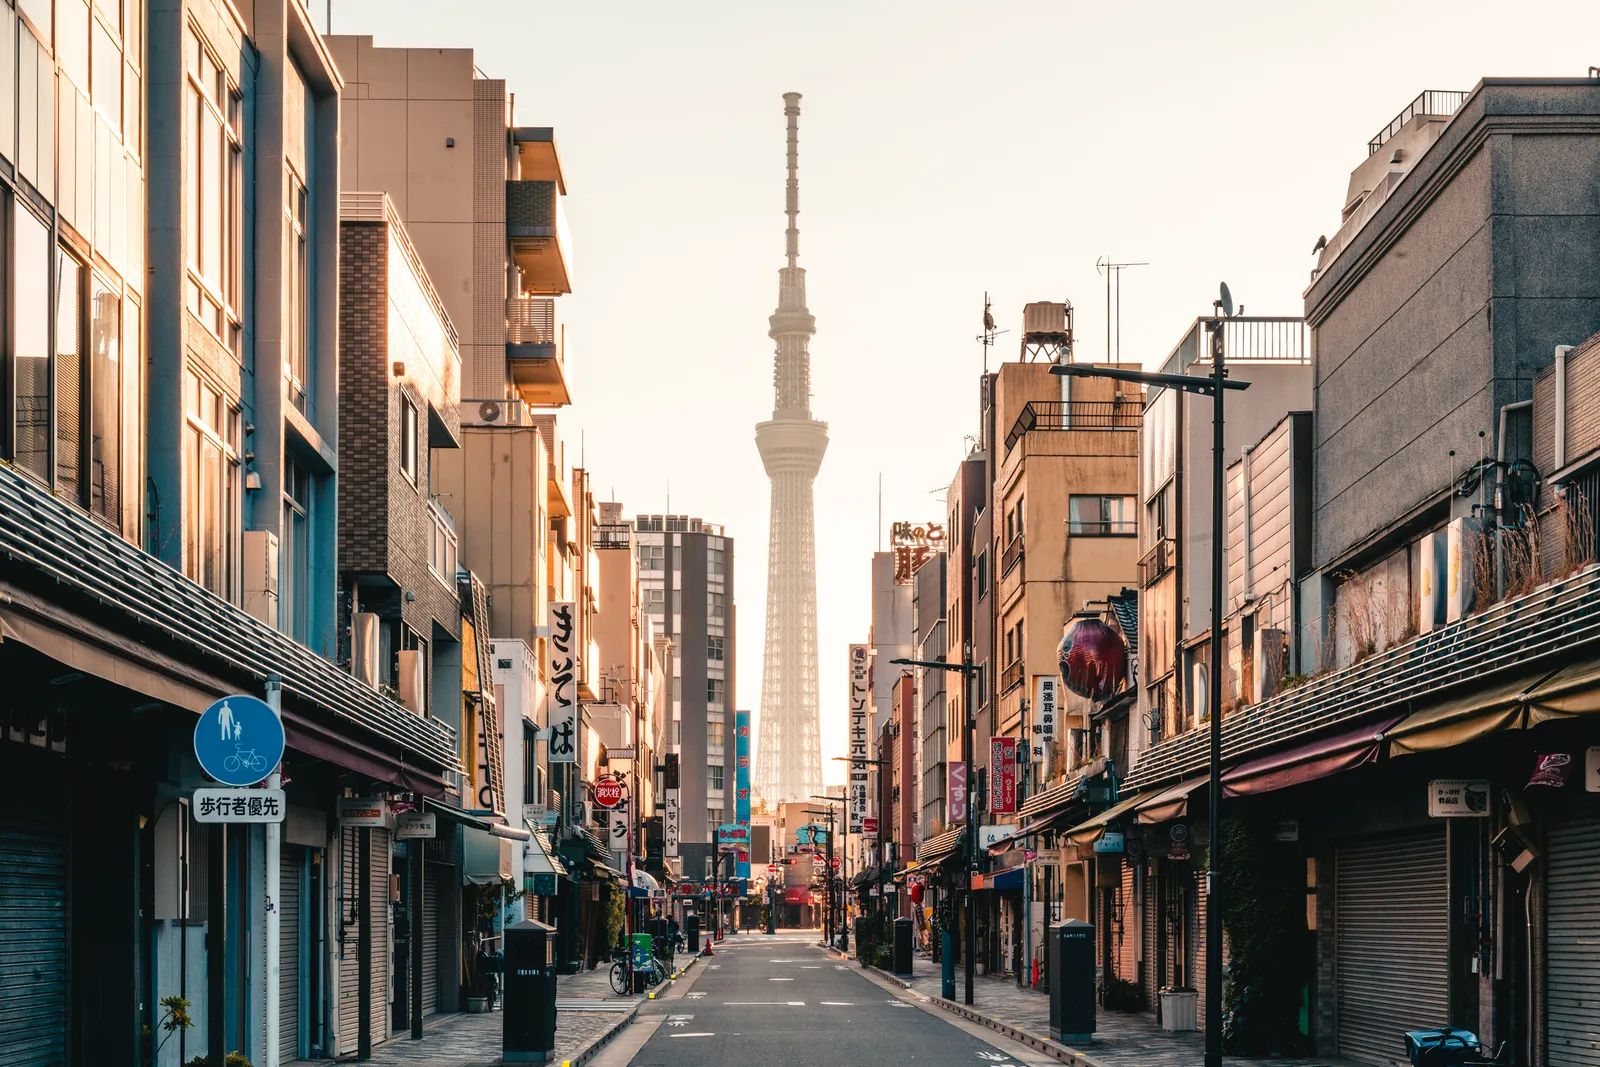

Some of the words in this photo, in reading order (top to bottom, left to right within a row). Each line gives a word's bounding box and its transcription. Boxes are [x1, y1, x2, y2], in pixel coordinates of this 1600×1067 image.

[893, 521, 948, 541] 味のと
[851, 682, 866, 770] トンテキ元気
[200, 796, 279, 816] 歩行者優先
[597, 786, 620, 798] 消火栓
[951, 765, 967, 820] くすり
[667, 798, 677, 847] 浅草今半
